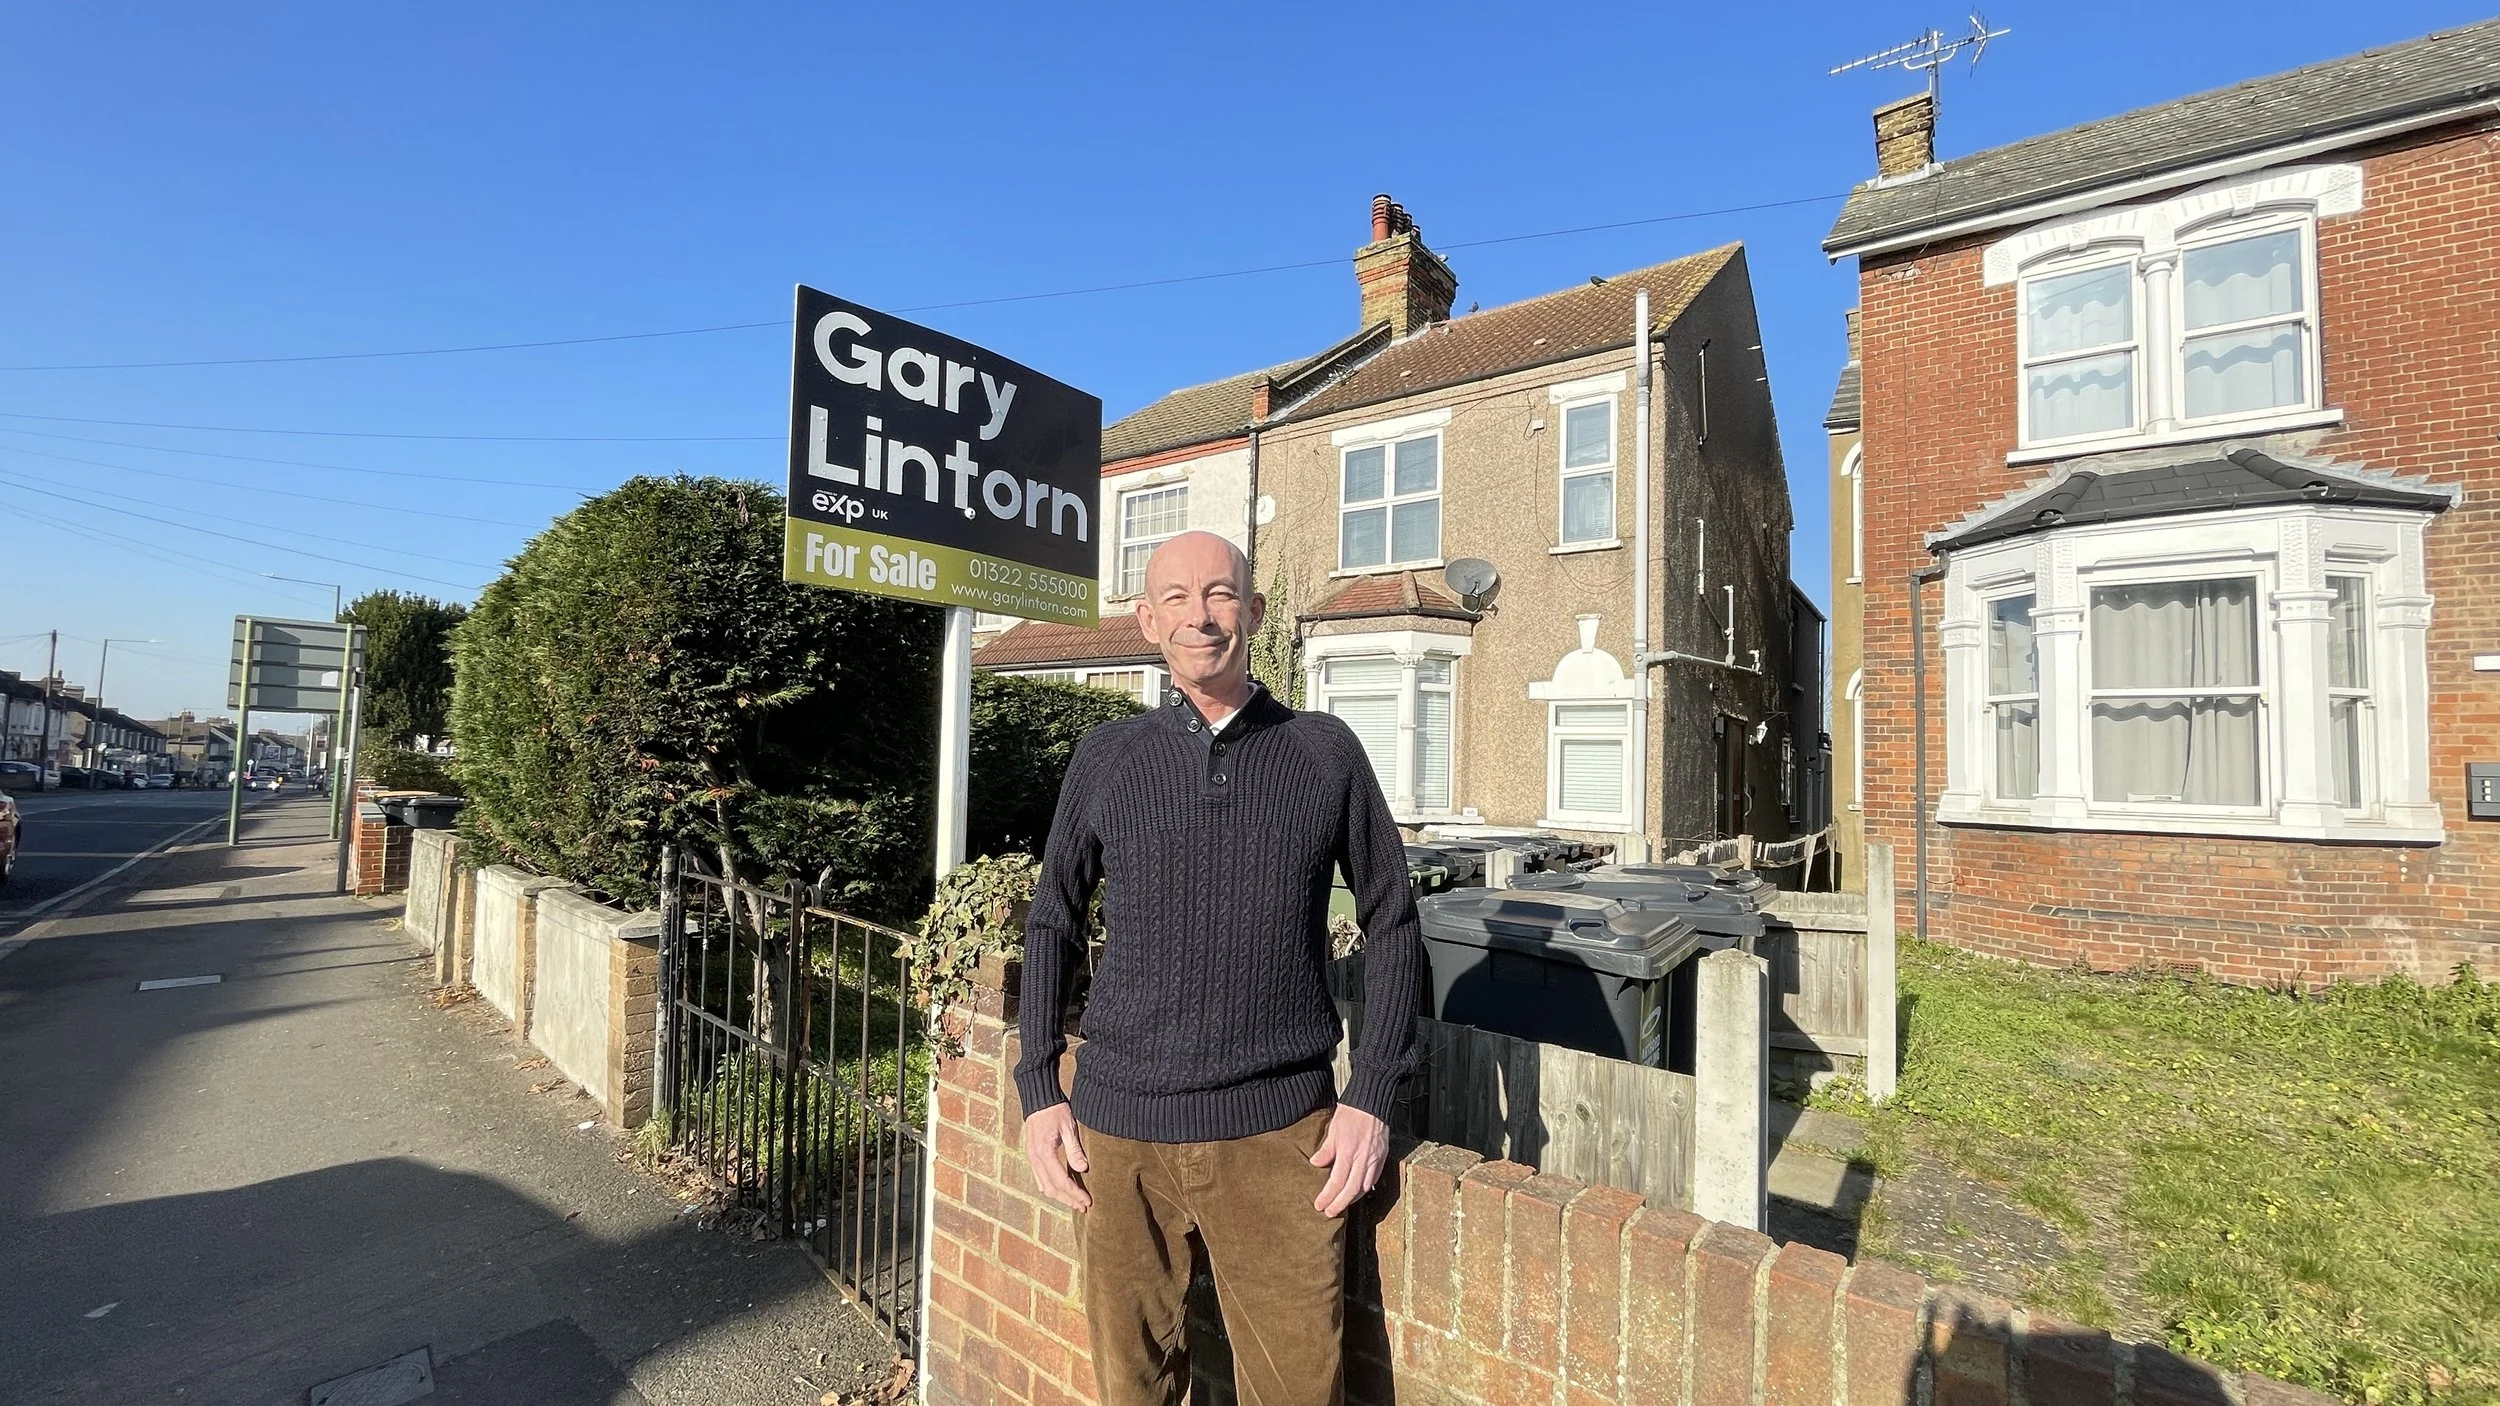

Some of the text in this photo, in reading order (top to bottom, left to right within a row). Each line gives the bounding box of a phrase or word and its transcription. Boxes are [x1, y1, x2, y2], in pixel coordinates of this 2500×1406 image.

[814, 311, 1018, 441] Gary
[808, 405, 1088, 543] Lintorn
[872, 508, 889, 520] UK
[806, 532, 937, 591] For Sale
[951, 583, 1088, 619] www.garylintorn.com
